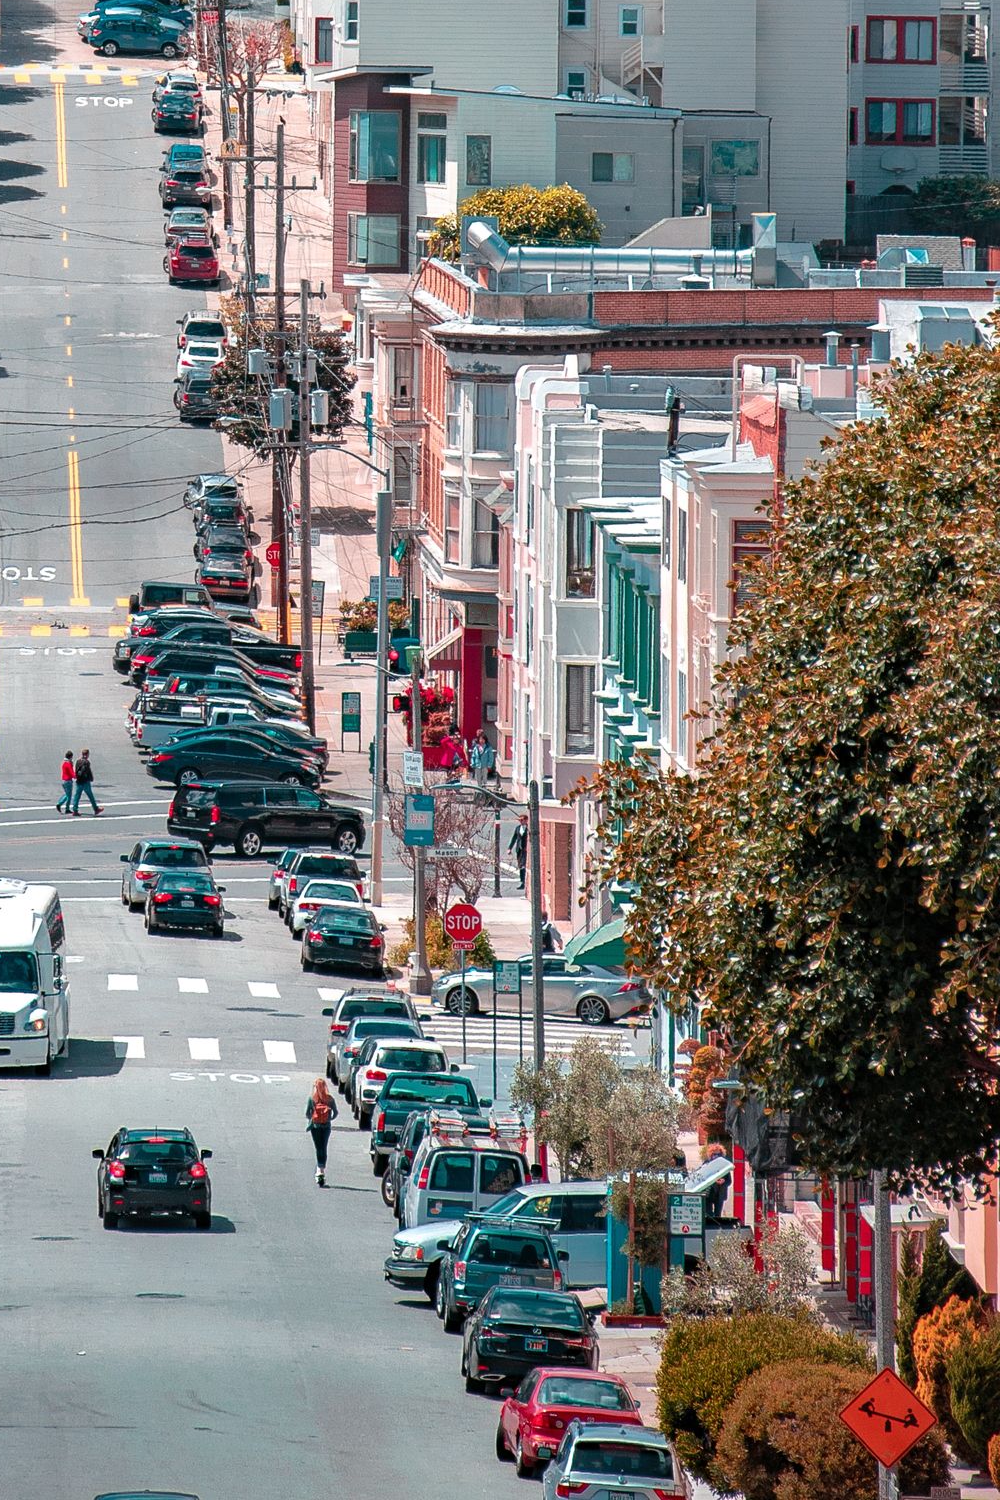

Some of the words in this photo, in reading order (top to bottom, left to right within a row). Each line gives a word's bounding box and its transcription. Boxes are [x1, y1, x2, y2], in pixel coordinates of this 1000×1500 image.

[75, 96, 134, 109] STOP
[19, 647, 98, 656] STOP
[447, 915, 480, 930] STOP
[168, 1070, 292, 1083] STOP
[673, 1196, 680, 1205] 2
